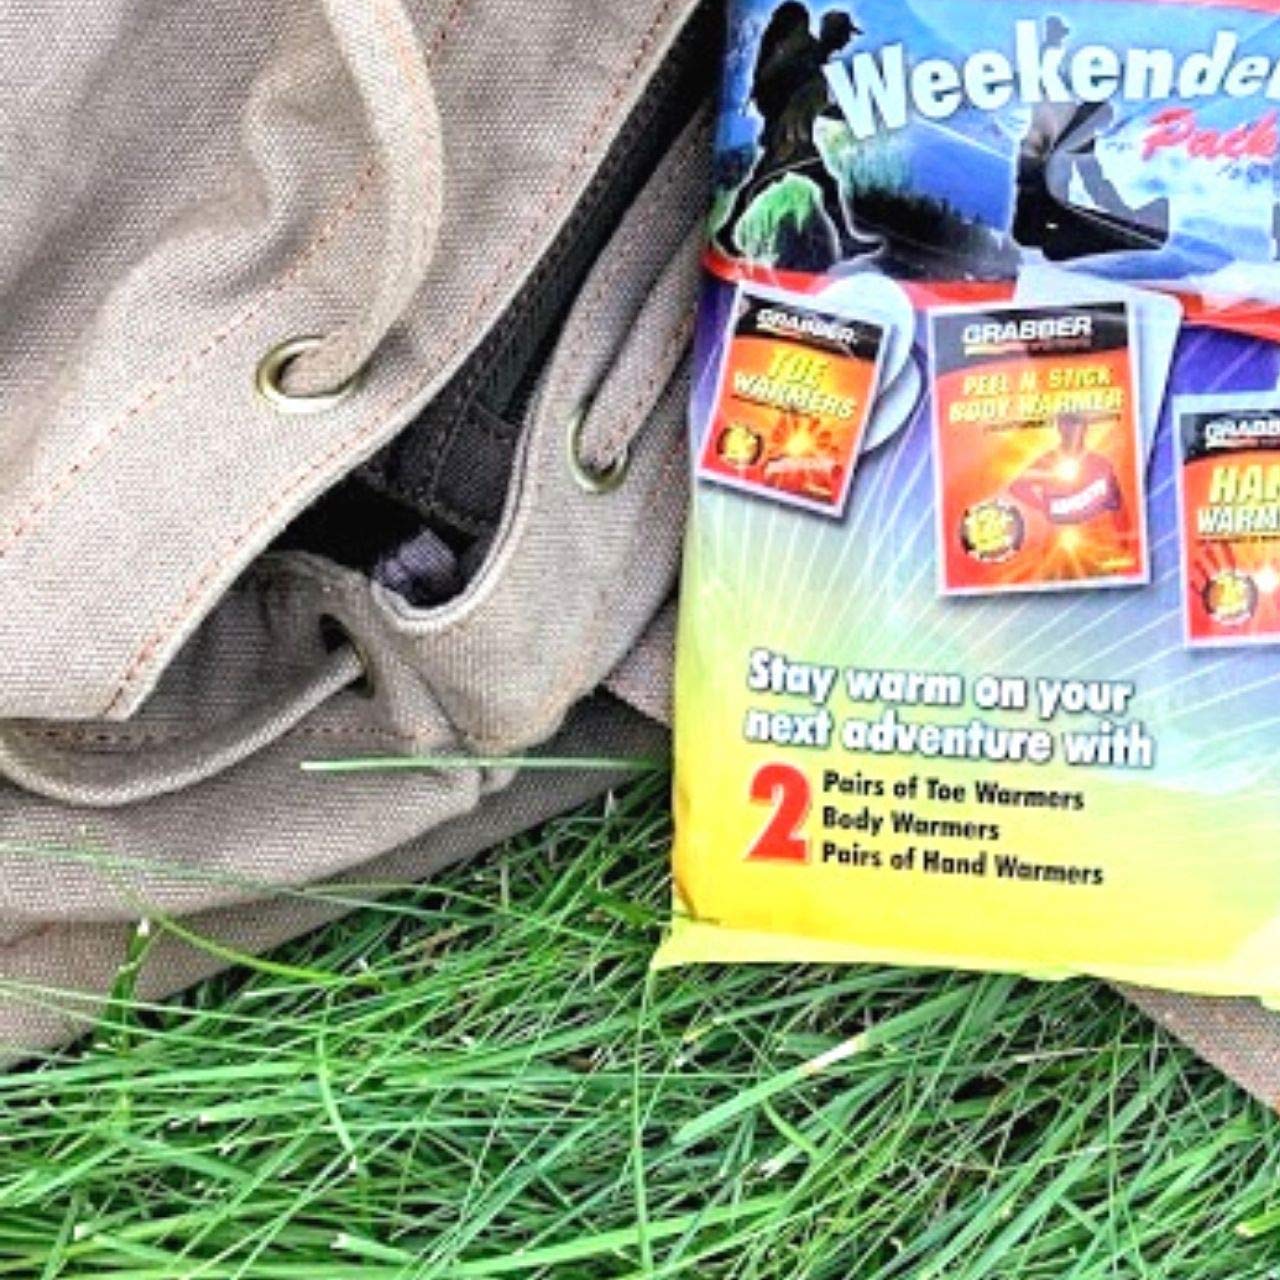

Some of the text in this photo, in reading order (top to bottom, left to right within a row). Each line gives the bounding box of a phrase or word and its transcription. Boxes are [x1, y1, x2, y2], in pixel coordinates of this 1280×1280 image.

[963, 315, 1092, 345] GRABBER
[747, 649, 1136, 720] Stay warm on your
[745, 708, 1157, 767] next adventure with
[823, 770, 1085, 811] Pairs of Toe Warmers
[744, 761, 811, 865] 2
[823, 806, 1000, 840] Body Warmers
[822, 842, 1104, 886] Pairs of Hand Warmers
